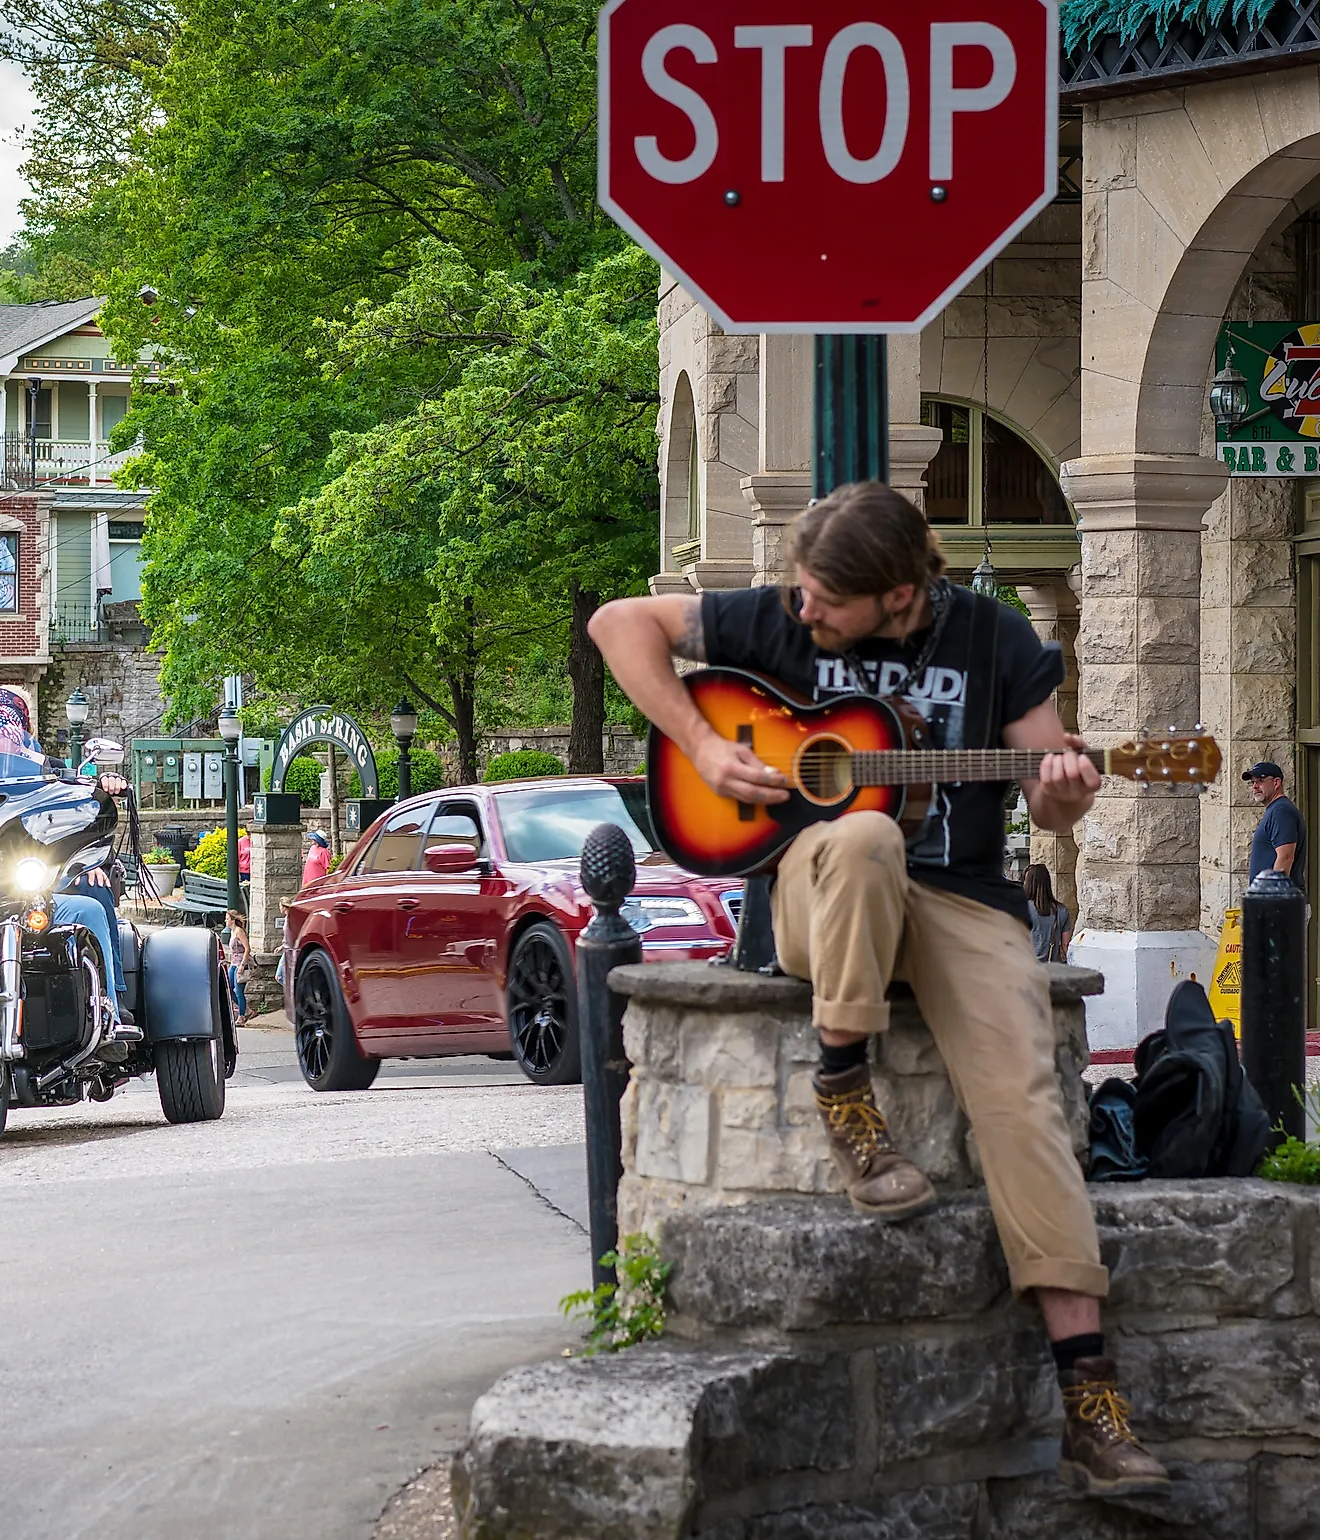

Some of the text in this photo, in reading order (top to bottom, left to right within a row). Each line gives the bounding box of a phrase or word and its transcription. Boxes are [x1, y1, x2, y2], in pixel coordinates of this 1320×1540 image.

[633, 21, 1018, 185] STOP
[1223, 446, 1320, 472] BAR & B
[879, 661, 968, 704] DUD
[280, 714, 368, 768] BASIN SPRING
[1216, 961, 1232, 984] ACHTUNG
